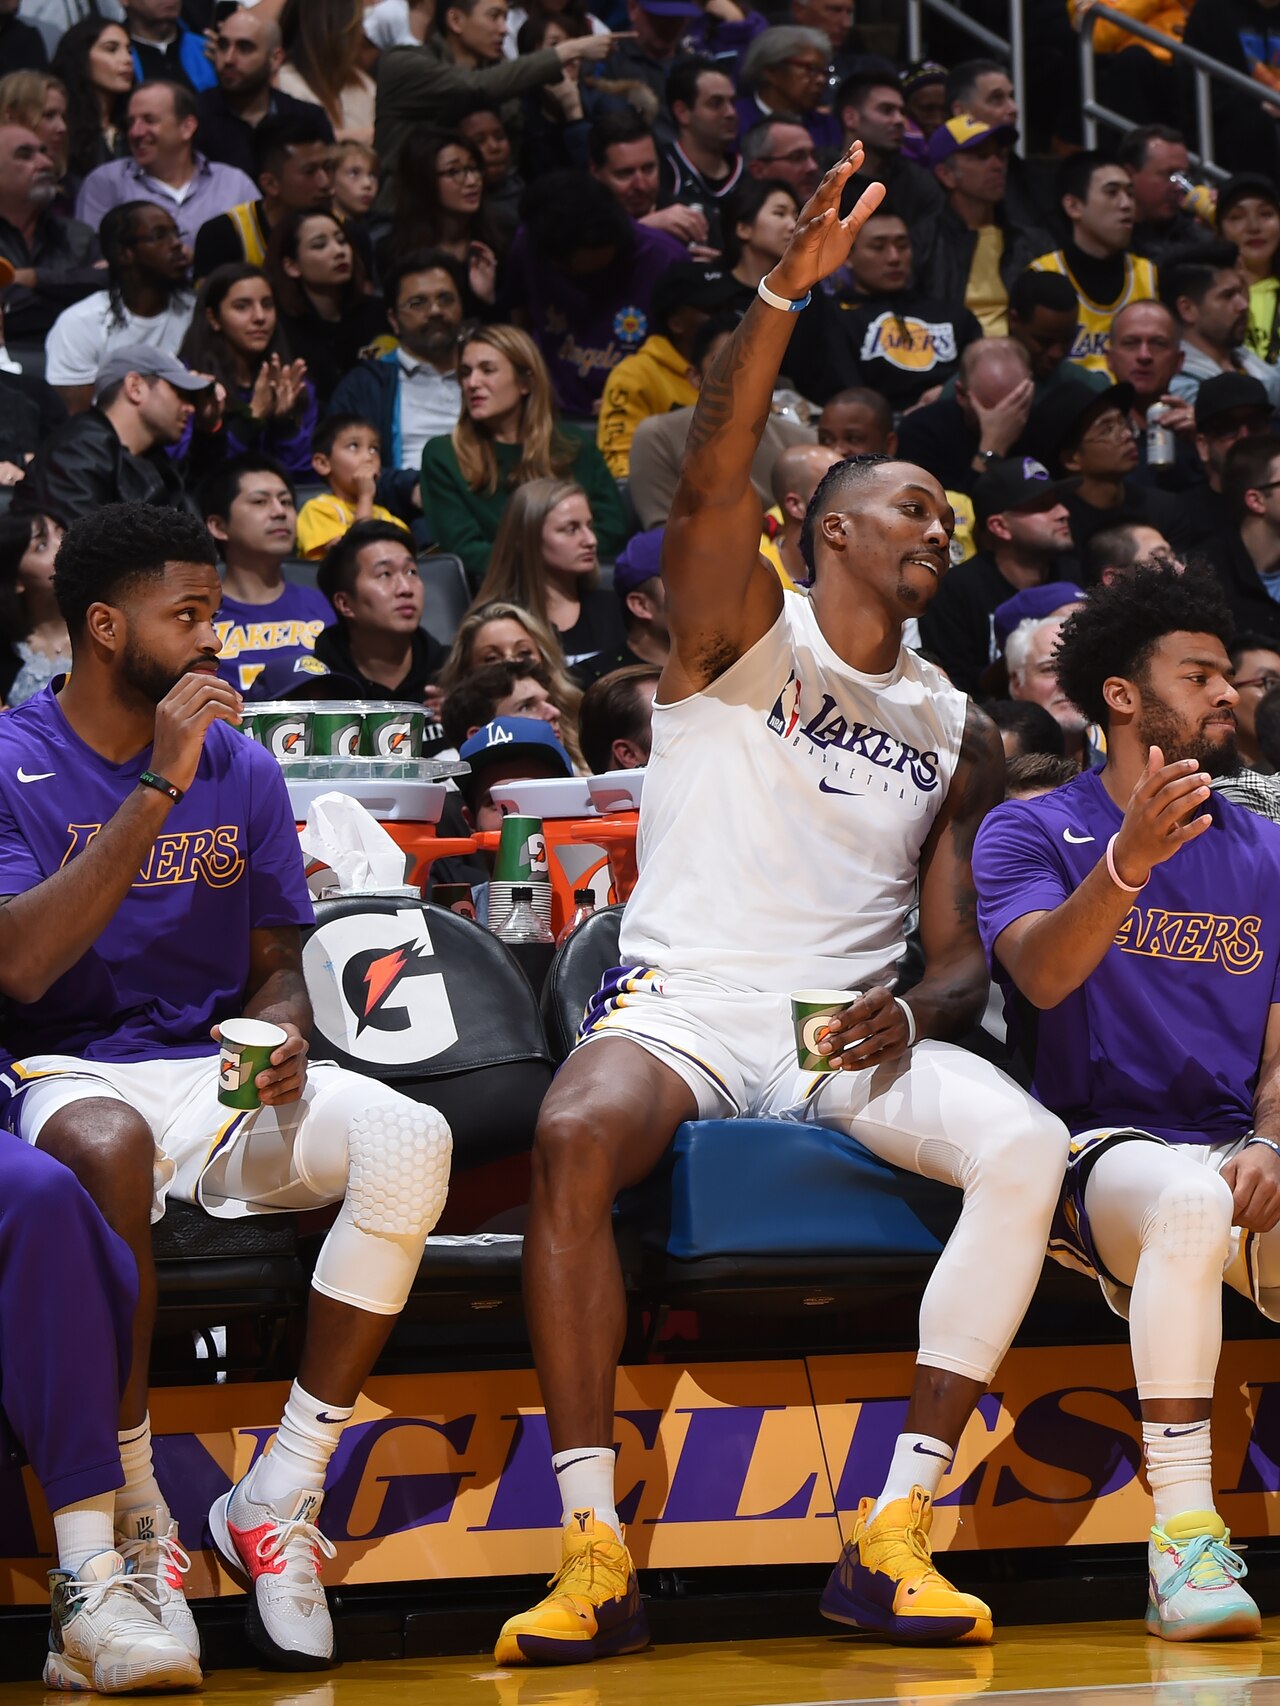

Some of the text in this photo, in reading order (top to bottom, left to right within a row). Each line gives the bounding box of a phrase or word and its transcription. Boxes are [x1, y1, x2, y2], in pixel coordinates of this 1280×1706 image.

[213, 619, 325, 660] LAKERS
[485, 721, 514, 747] LA
[769, 715, 785, 733] NBA
[800, 693, 938, 792] LAKERS
[58, 823, 246, 889] LERS
[1112, 905, 1264, 976] AKERS
[302, 908, 460, 1065] G
